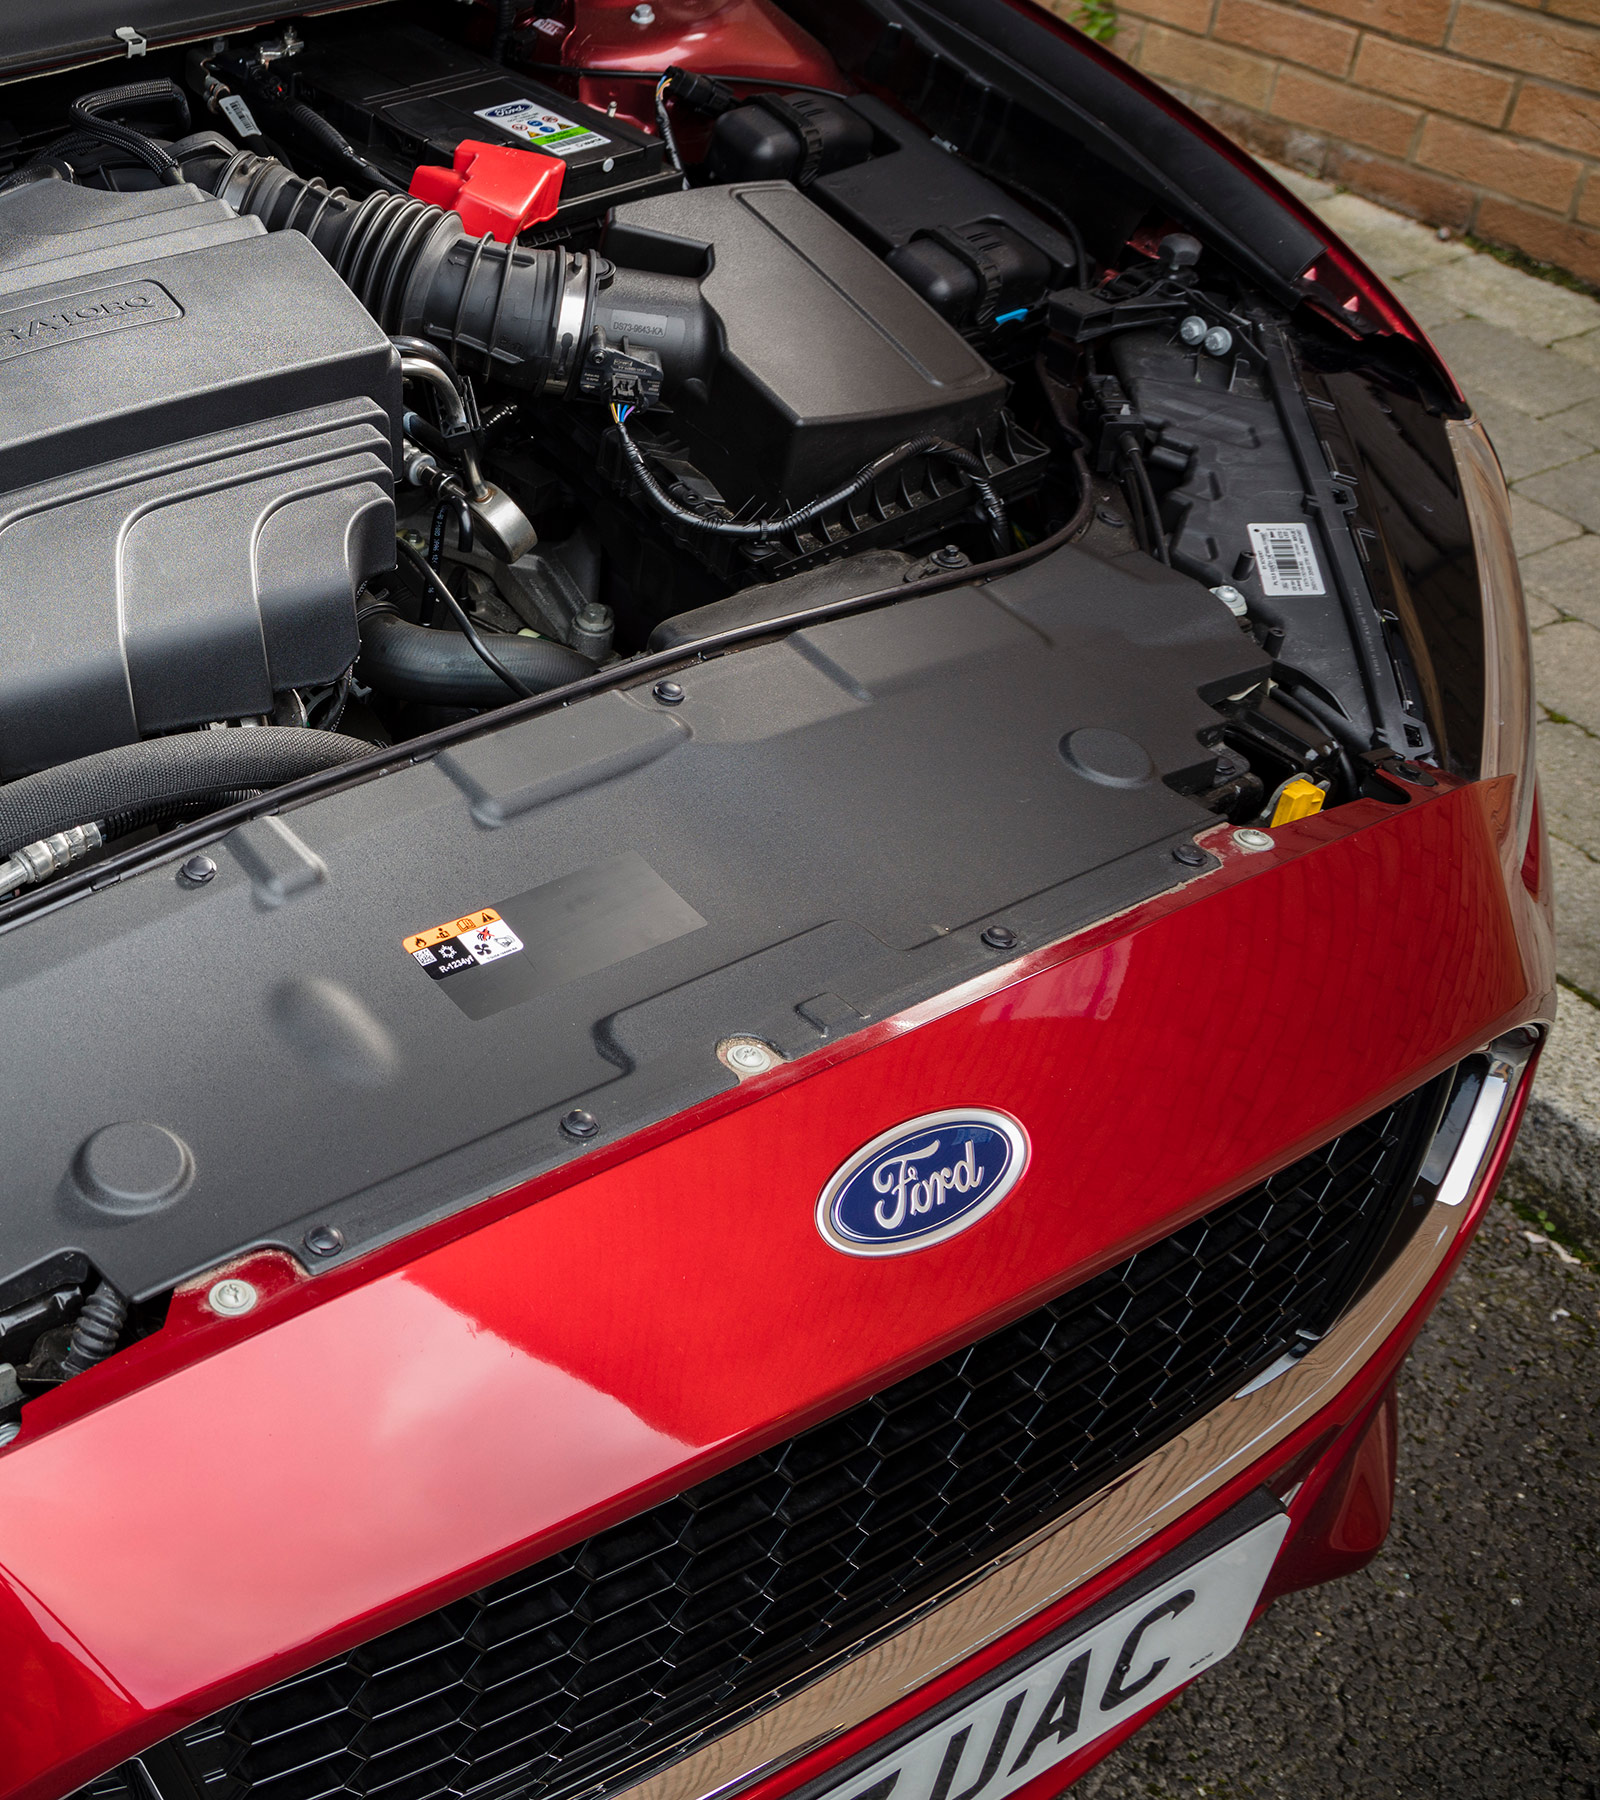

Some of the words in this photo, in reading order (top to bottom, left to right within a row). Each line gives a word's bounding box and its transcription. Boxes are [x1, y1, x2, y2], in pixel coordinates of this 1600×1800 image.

[438, 955, 475, 973] R-1234yf
[872, 1139, 985, 1230] Ford
[929, 1589, 1196, 1800] UAC
